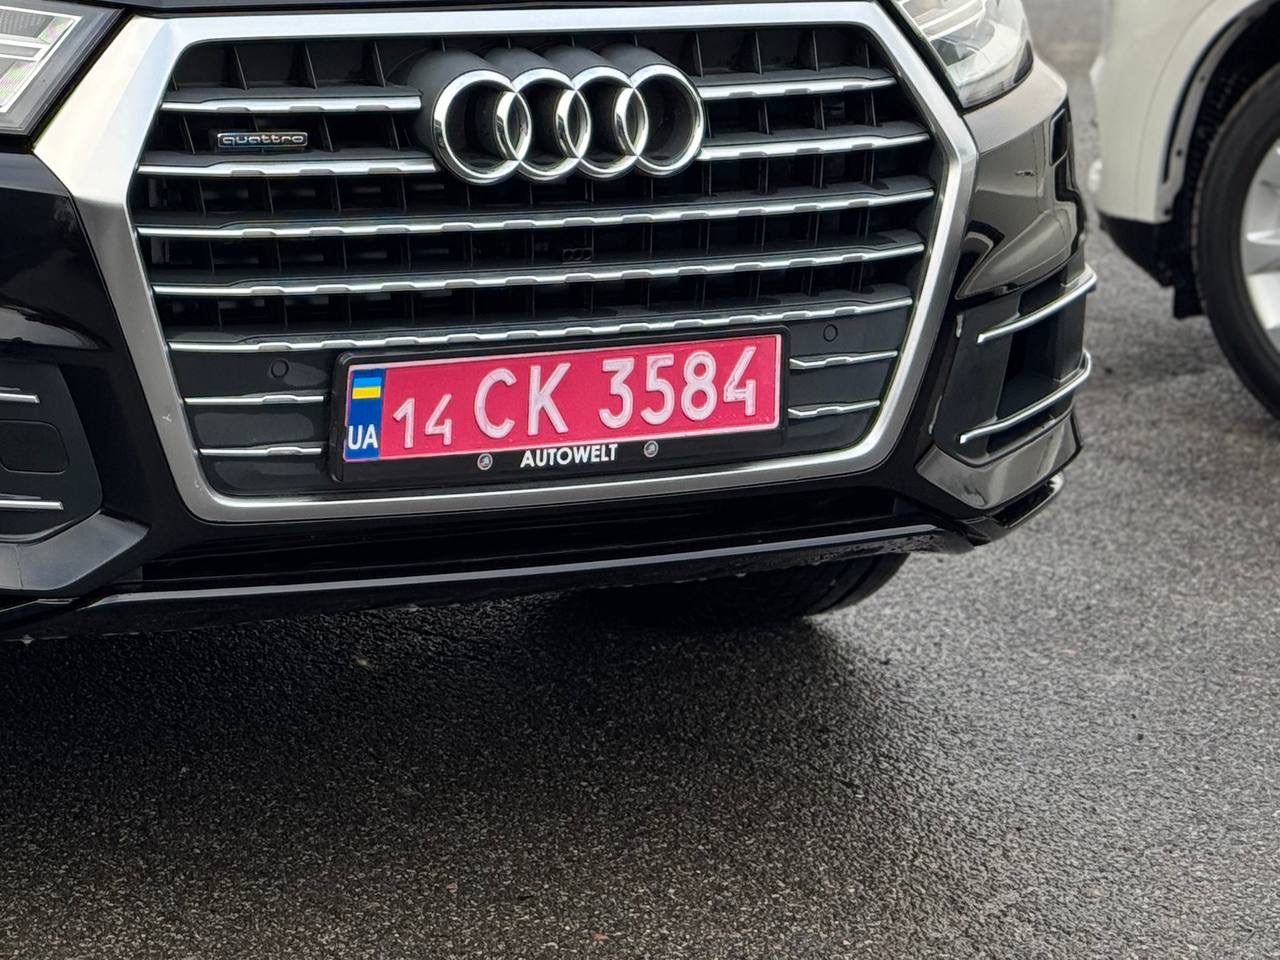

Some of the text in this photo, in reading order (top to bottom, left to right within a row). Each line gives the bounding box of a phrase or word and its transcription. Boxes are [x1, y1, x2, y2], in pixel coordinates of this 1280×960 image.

[222, 134, 304, 145] quattro
[392, 345, 758, 449] 14 CK 3584
[348, 424, 379, 451] UA
[520, 443, 618, 468] AUTOWELT
